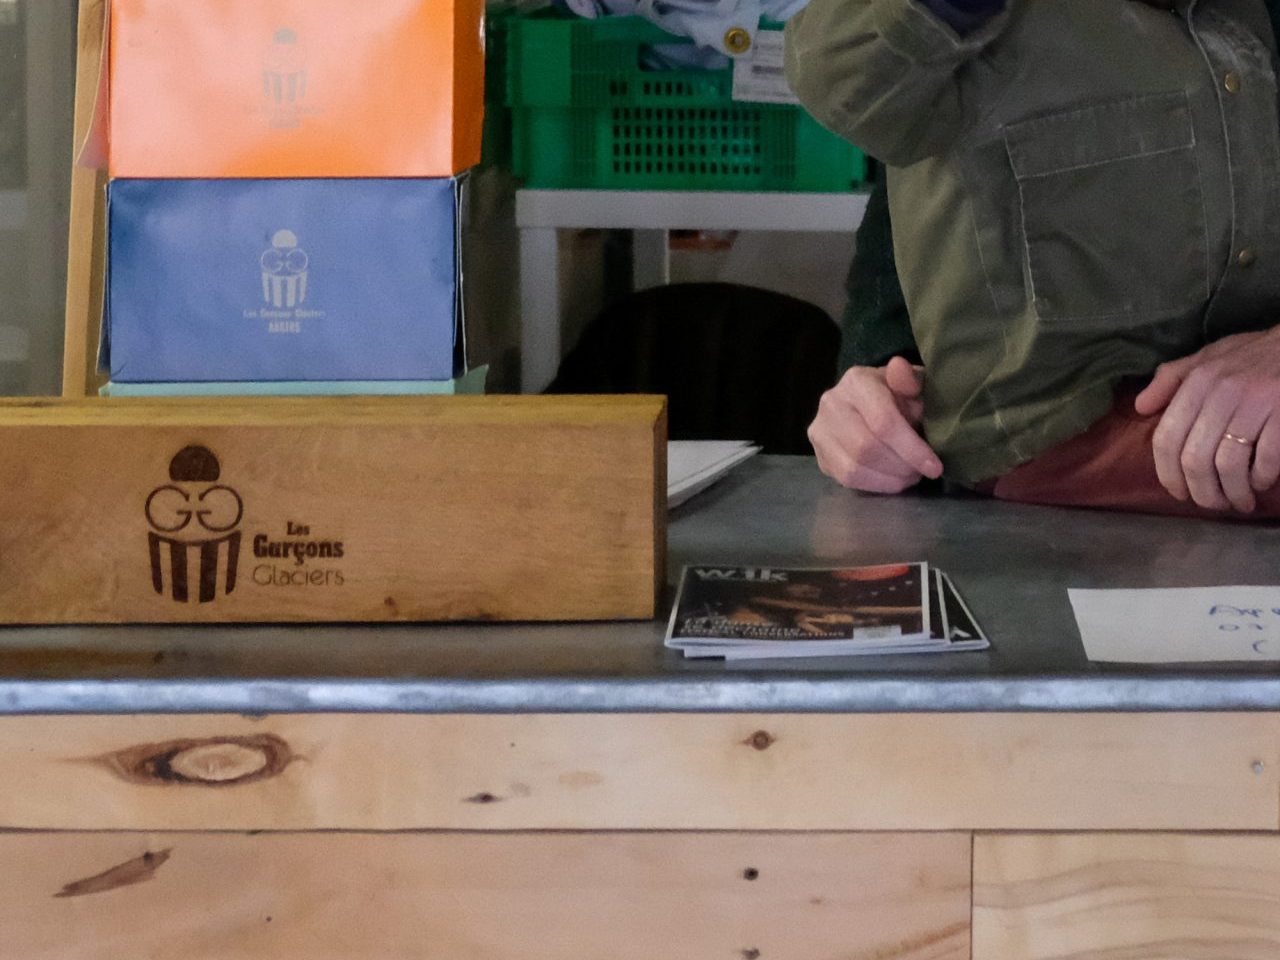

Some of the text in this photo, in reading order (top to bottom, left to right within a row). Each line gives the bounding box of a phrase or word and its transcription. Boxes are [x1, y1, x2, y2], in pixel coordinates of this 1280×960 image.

[287, 521, 310, 536] Les
[253, 534, 345, 565] Garçons
[252, 564, 345, 587] Glaciers
